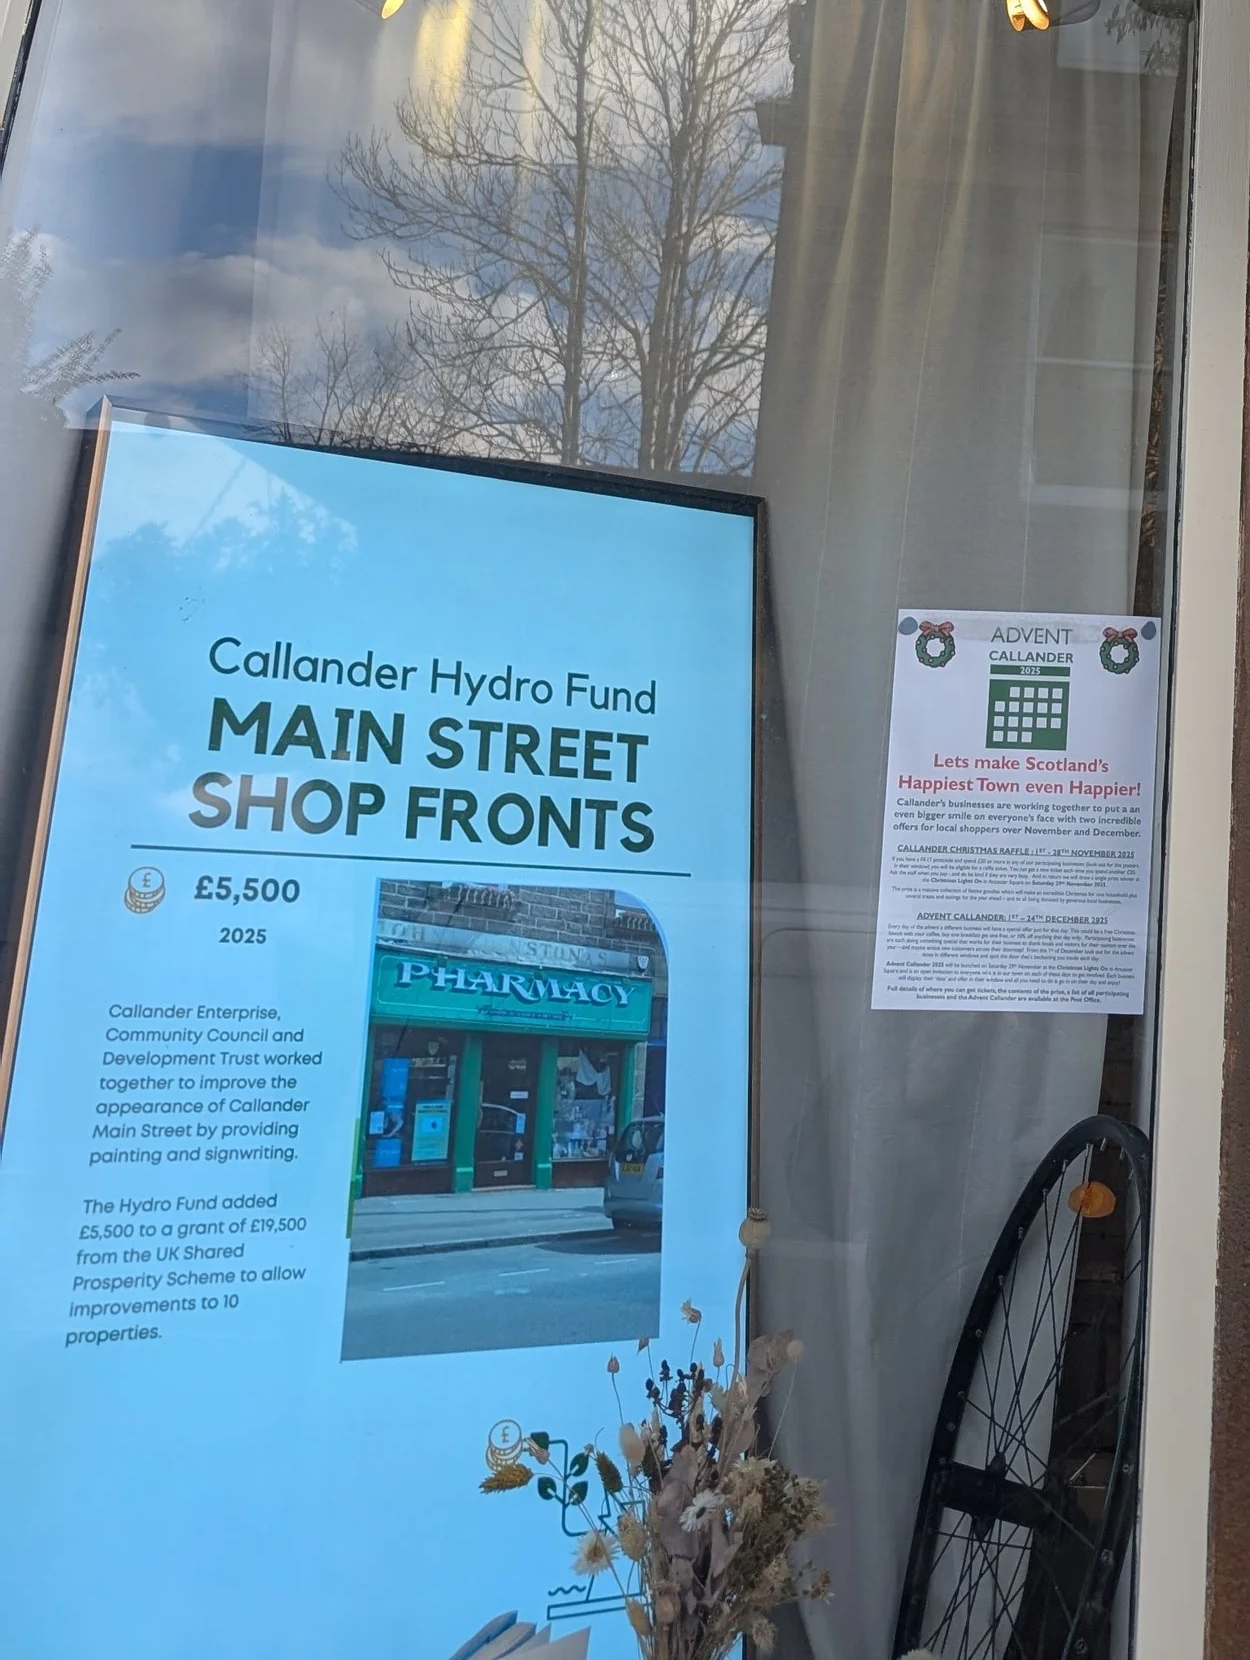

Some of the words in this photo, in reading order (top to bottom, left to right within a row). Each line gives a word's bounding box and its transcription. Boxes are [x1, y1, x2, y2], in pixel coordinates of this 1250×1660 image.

[990, 625, 1073, 645] ADVENT
[988, 650, 1073, 663] CALLANDER
[208, 637, 418, 690] Callander
[430, 658, 553, 706] Hydro
[566, 671, 656, 714] Fund
[1020, 666, 1041, 675] 2025
[207, 697, 405, 765] MAIN
[425, 716, 649, 783] STREET
[933, 752, 969, 768] Lets
[974, 755, 1020, 770] make
[1025, 756, 1108, 772] Scotland's
[898, 774, 974, 794] Happiest
[975, 777, 1019, 792] Town
[1024, 782, 1063, 794] even
[1068, 779, 1140, 799] Happier!
[188, 772, 385, 835] SHOP
[405, 786, 654, 853] FRONTS
[896, 797, 946, 807] Callander's
[948, 799, 994, 809] businesses
[1013, 801, 1049, 813] working
[1051, 803, 1090, 813] together
[1092, 804, 1102, 812] to
[1104, 805, 1120, 814] put
[916, 809, 946, 821] bigger
[947, 811, 972, 820] smile
[987, 813, 1034, 823] everyone's
[1036, 813, 1054, 822] face
[1056, 814, 1076, 823] with
[1078, 816, 1096, 824] two
[1098, 815, 1141, 825] incredible
[892, 821, 918, 831] offers
[920, 822, 934, 831] for
[935, 823, 957, 832] local
[959, 823, 1000, 835] shoppers
[1001, 826, 1022, 834] over
[1024, 825, 1072, 835] November
[1073, 827, 1090, 836] and
[1092, 827, 1140, 837] December.
[896, 844, 948, 853] CALLANDER
[949, 845, 997, 855] CHRISTMAS
[998, 847, 1029, 856] RAFFLE
[1070, 849, 1116, 858] NOVEMBER
[1117, 850, 1134, 859] 2025
[193, 874, 300, 906] £5,500
[916, 911, 952, 921] ADVENT
[952, 912, 1006, 922] CALLANDER:
[1044, 914, 1089, 924] DECEMBER
[1090, 916, 1108, 925] 2025
[218, 926, 266, 944] 2025
[400, 961, 636, 1006] PHARMACY
[108, 1003, 193, 1018] Callander
[196, 1004, 280, 1022] Enterprise,
[105, 1027, 203, 1048] Community
[206, 1027, 268, 1042] Council
[271, 1027, 304, 1042] and
[102, 1050, 216, 1068] Development
[219, 1051, 260, 1065] Trust
[263, 1050, 322, 1065] worked
[99, 1075, 174, 1093] together
[178, 1076, 195, 1089] to
[199, 1074, 266, 1092] improve
[270, 1074, 297, 1089] the
[95, 1101, 203, 1117] appearance
[207, 1097, 226, 1113] of
[228, 1097, 310, 1112] Callander
[91, 1123, 136, 1139] Main
[140, 1123, 192, 1138] Street
[195, 1122, 218, 1140] by
[220, 1121, 299, 1140] providing
[88, 1147, 162, 1166] painting
[166, 1146, 201, 1162] and
[204, 1144, 300, 1164] signwriting.
[82, 1198, 114, 1214] The
[118, 1196, 171, 1216] Hydro
[175, 1194, 218, 1211] Fund
[221, 1192, 278, 1209] added
[78, 1223, 134, 1240] £5,500
[138, 1223, 156, 1237] to
[160, 1223, 173, 1236] a
[176, 1220, 225, 1239] grant
[228, 1217, 247, 1233] of
[249, 1216, 306, 1233] £19,500
[75, 1248, 117, 1265] from
[122, 1247, 151, 1263] the
[156, 1245, 180, 1261] UK
[182, 1242, 245, 1260] Shared
[72, 1271, 163, 1292] Prosperity
[166, 1269, 235, 1286] Scheme
[240, 1269, 257, 1282] to
[260, 1265, 306, 1281] allow
[68, 1297, 196, 1320] improvements
[200, 1296, 219, 1310] to
[223, 1293, 239, 1308] 10
[64, 1323, 162, 1348] properties.
